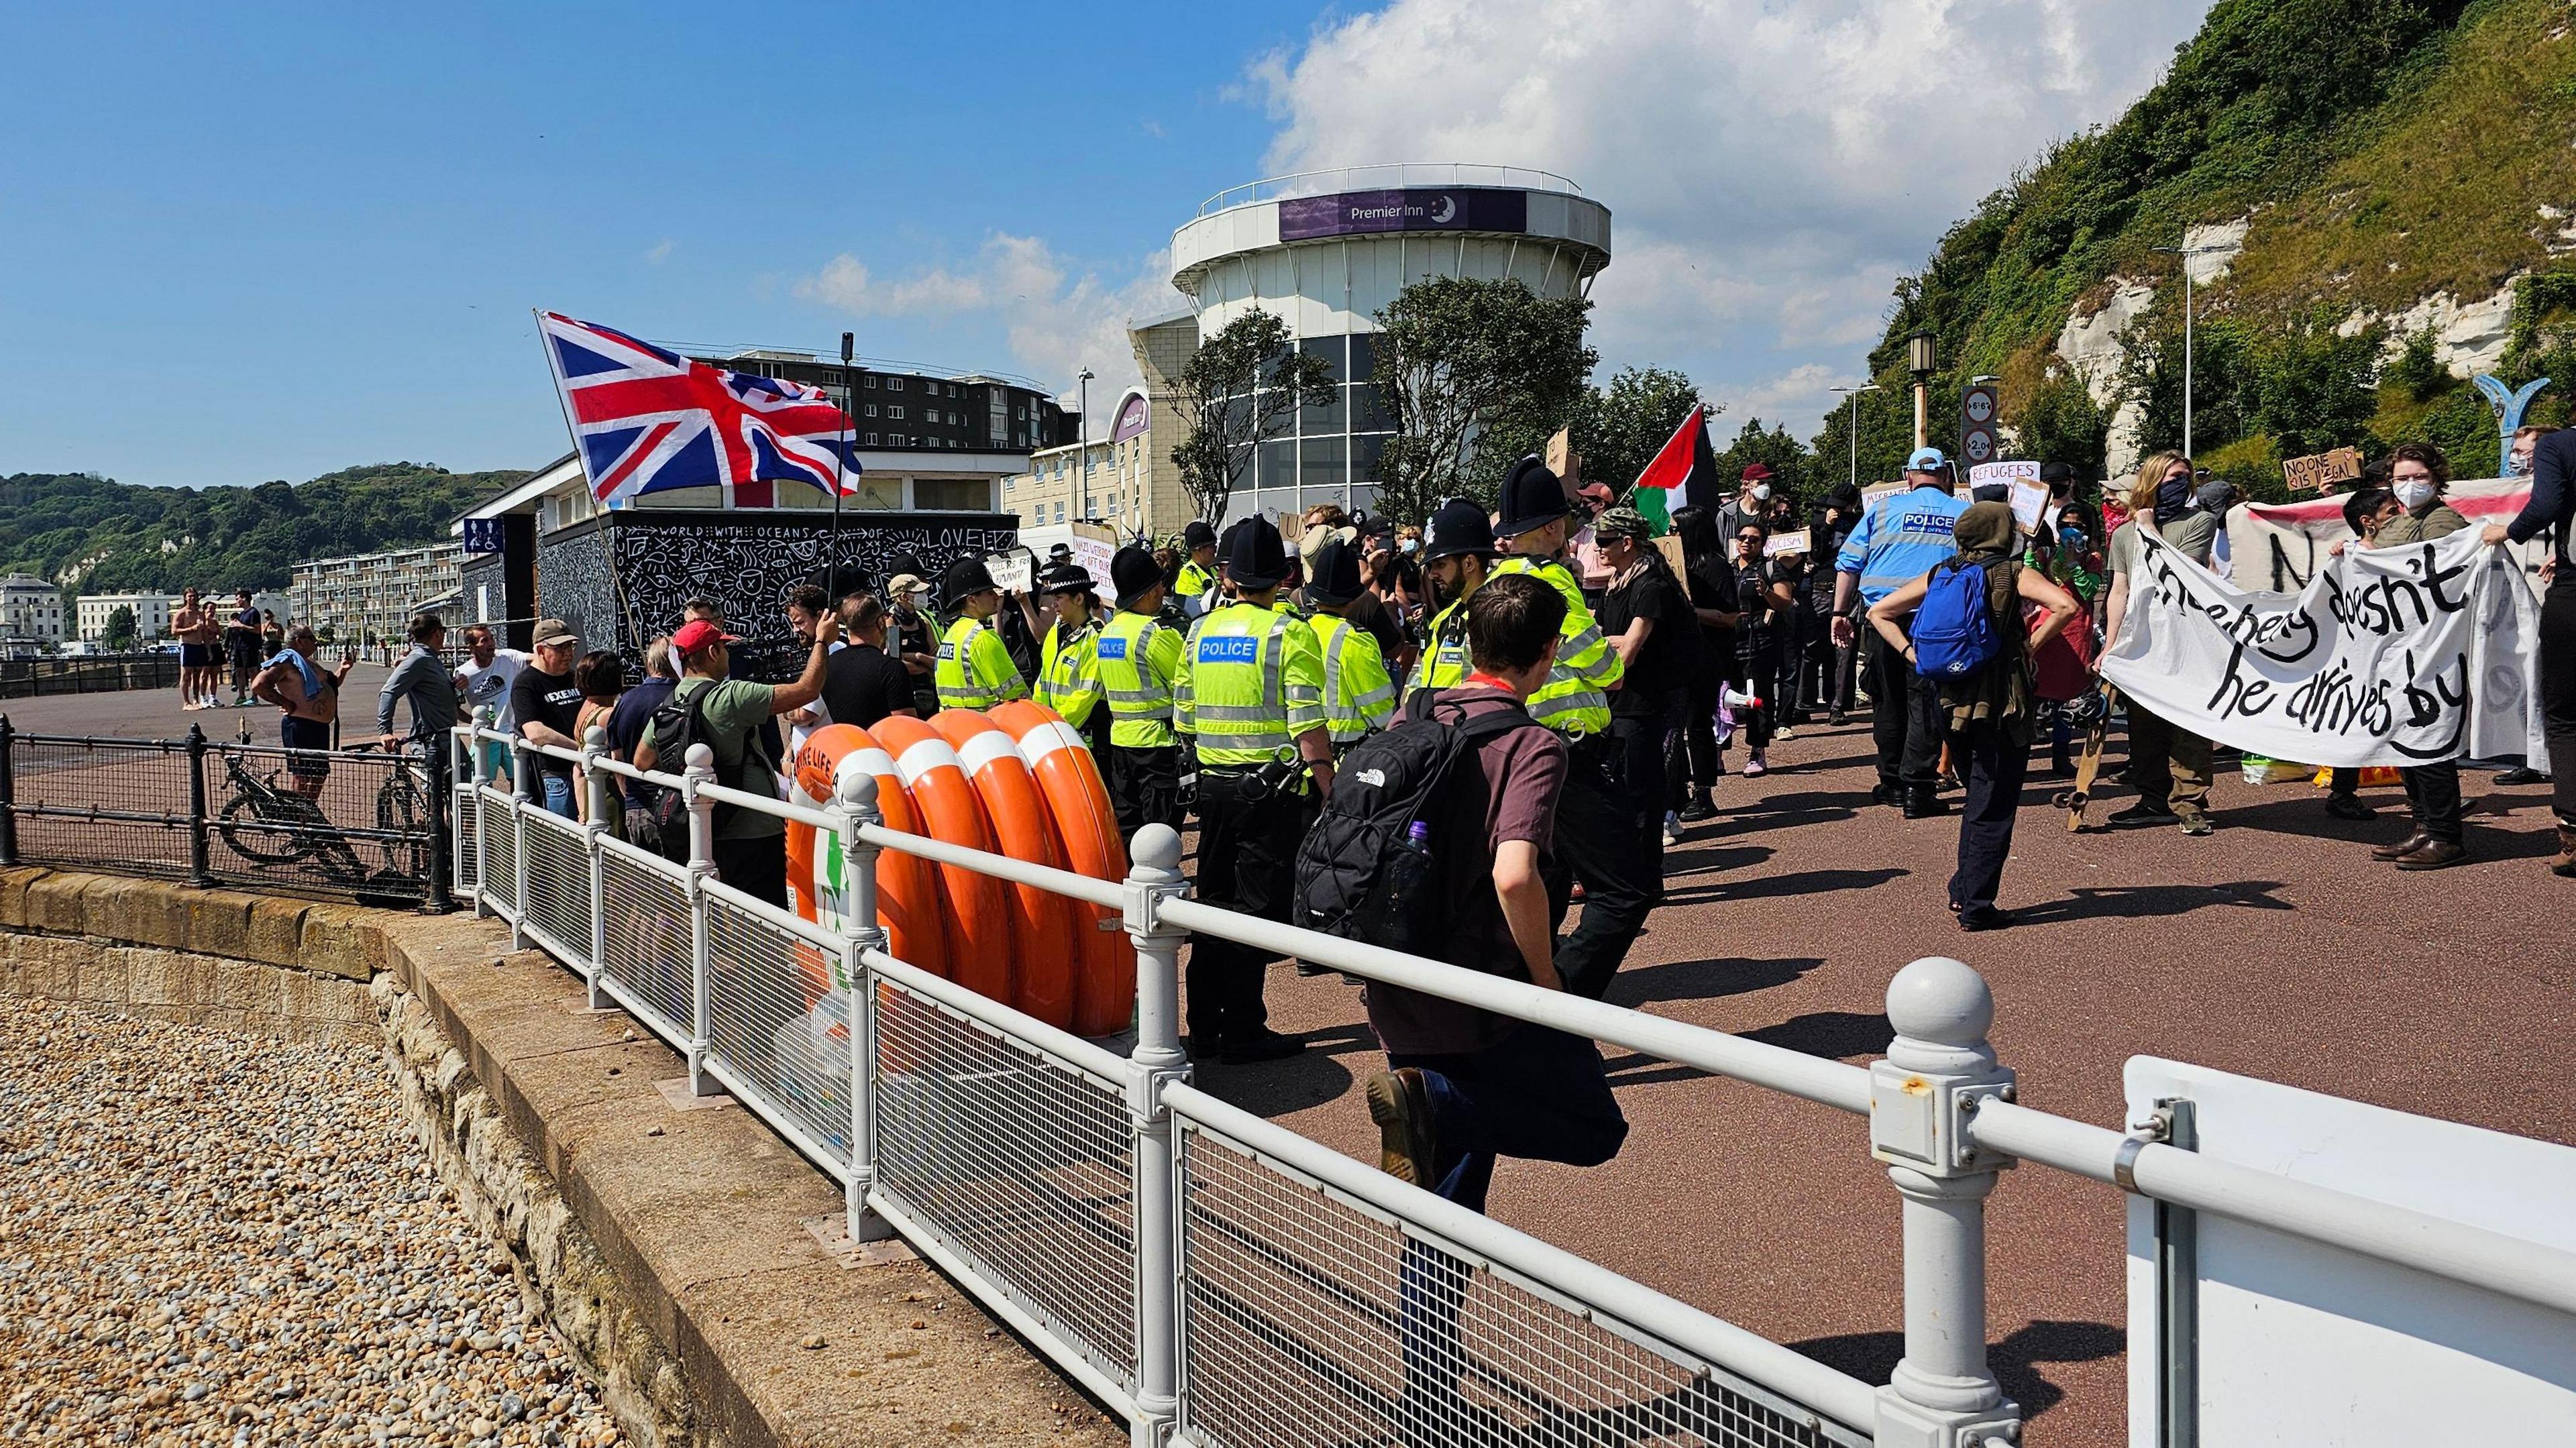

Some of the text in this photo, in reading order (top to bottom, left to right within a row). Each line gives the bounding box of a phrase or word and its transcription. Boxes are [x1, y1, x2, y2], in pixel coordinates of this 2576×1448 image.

[1351, 204, 1424, 219] Premier Inn
[1970, 440, 1986, 450] 2.0
[2285, 454, 2329, 477] NO ONE
[1972, 465, 2034, 482] REFUGEES
[2298, 474, 2310, 488] IS
[1904, 514, 1953, 528] POLICE
[659, 525, 982, 549] WORLD WITH OCEANS OF LOVE
[1765, 537, 1801, 550] RACISM
[2323, 543, 2469, 641] doesn't
[723, 601, 742, 613] ON
[1098, 643, 1124, 654] POLICE
[1201, 642, 1253, 657] POLICE
[2206, 641, 2468, 759] he arrives by
[813, 747, 832, 779] LIFE
